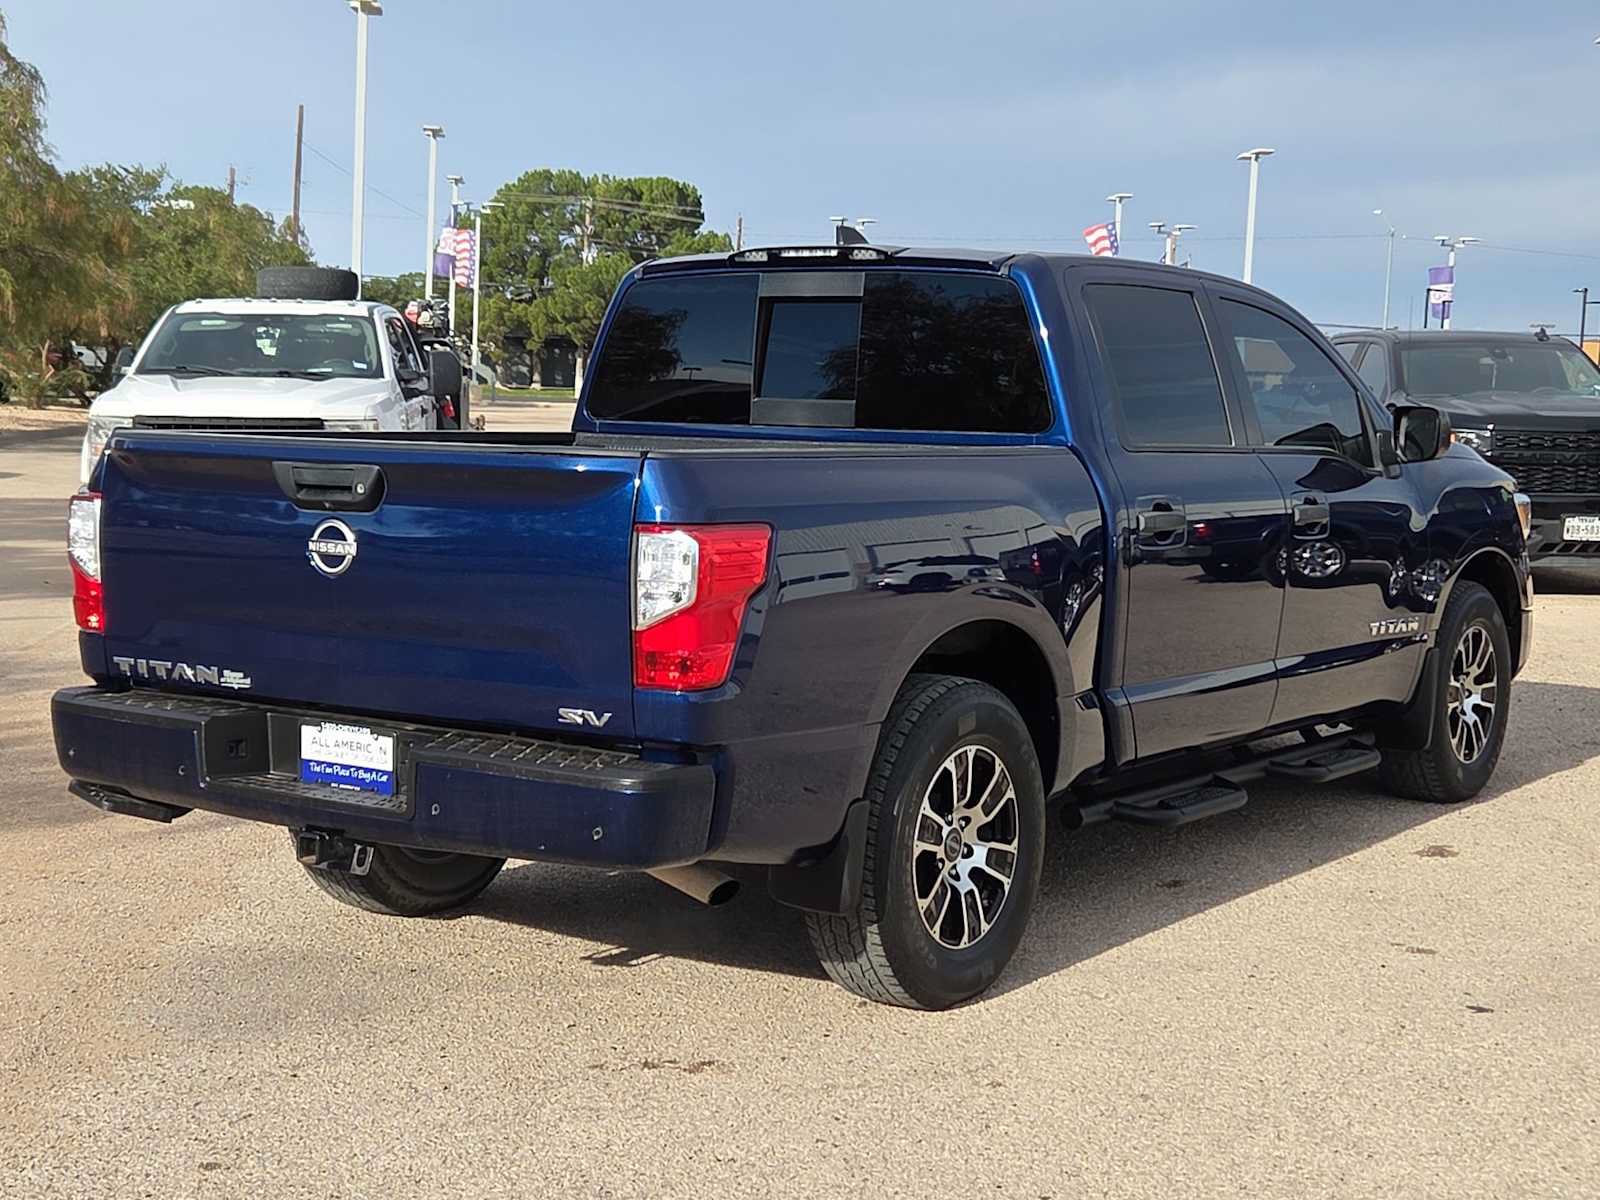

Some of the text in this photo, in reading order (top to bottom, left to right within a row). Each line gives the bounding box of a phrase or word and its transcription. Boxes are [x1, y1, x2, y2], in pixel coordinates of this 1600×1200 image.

[308, 541, 357, 556] NISSAN
[1370, 618, 1418, 636] TITAN
[112, 656, 219, 685] TITAN
[558, 707, 612, 727] SV
[311, 736, 387, 756] ALL AMERICN
[371, 771, 377, 782] A
[377, 773, 388, 782] Car
